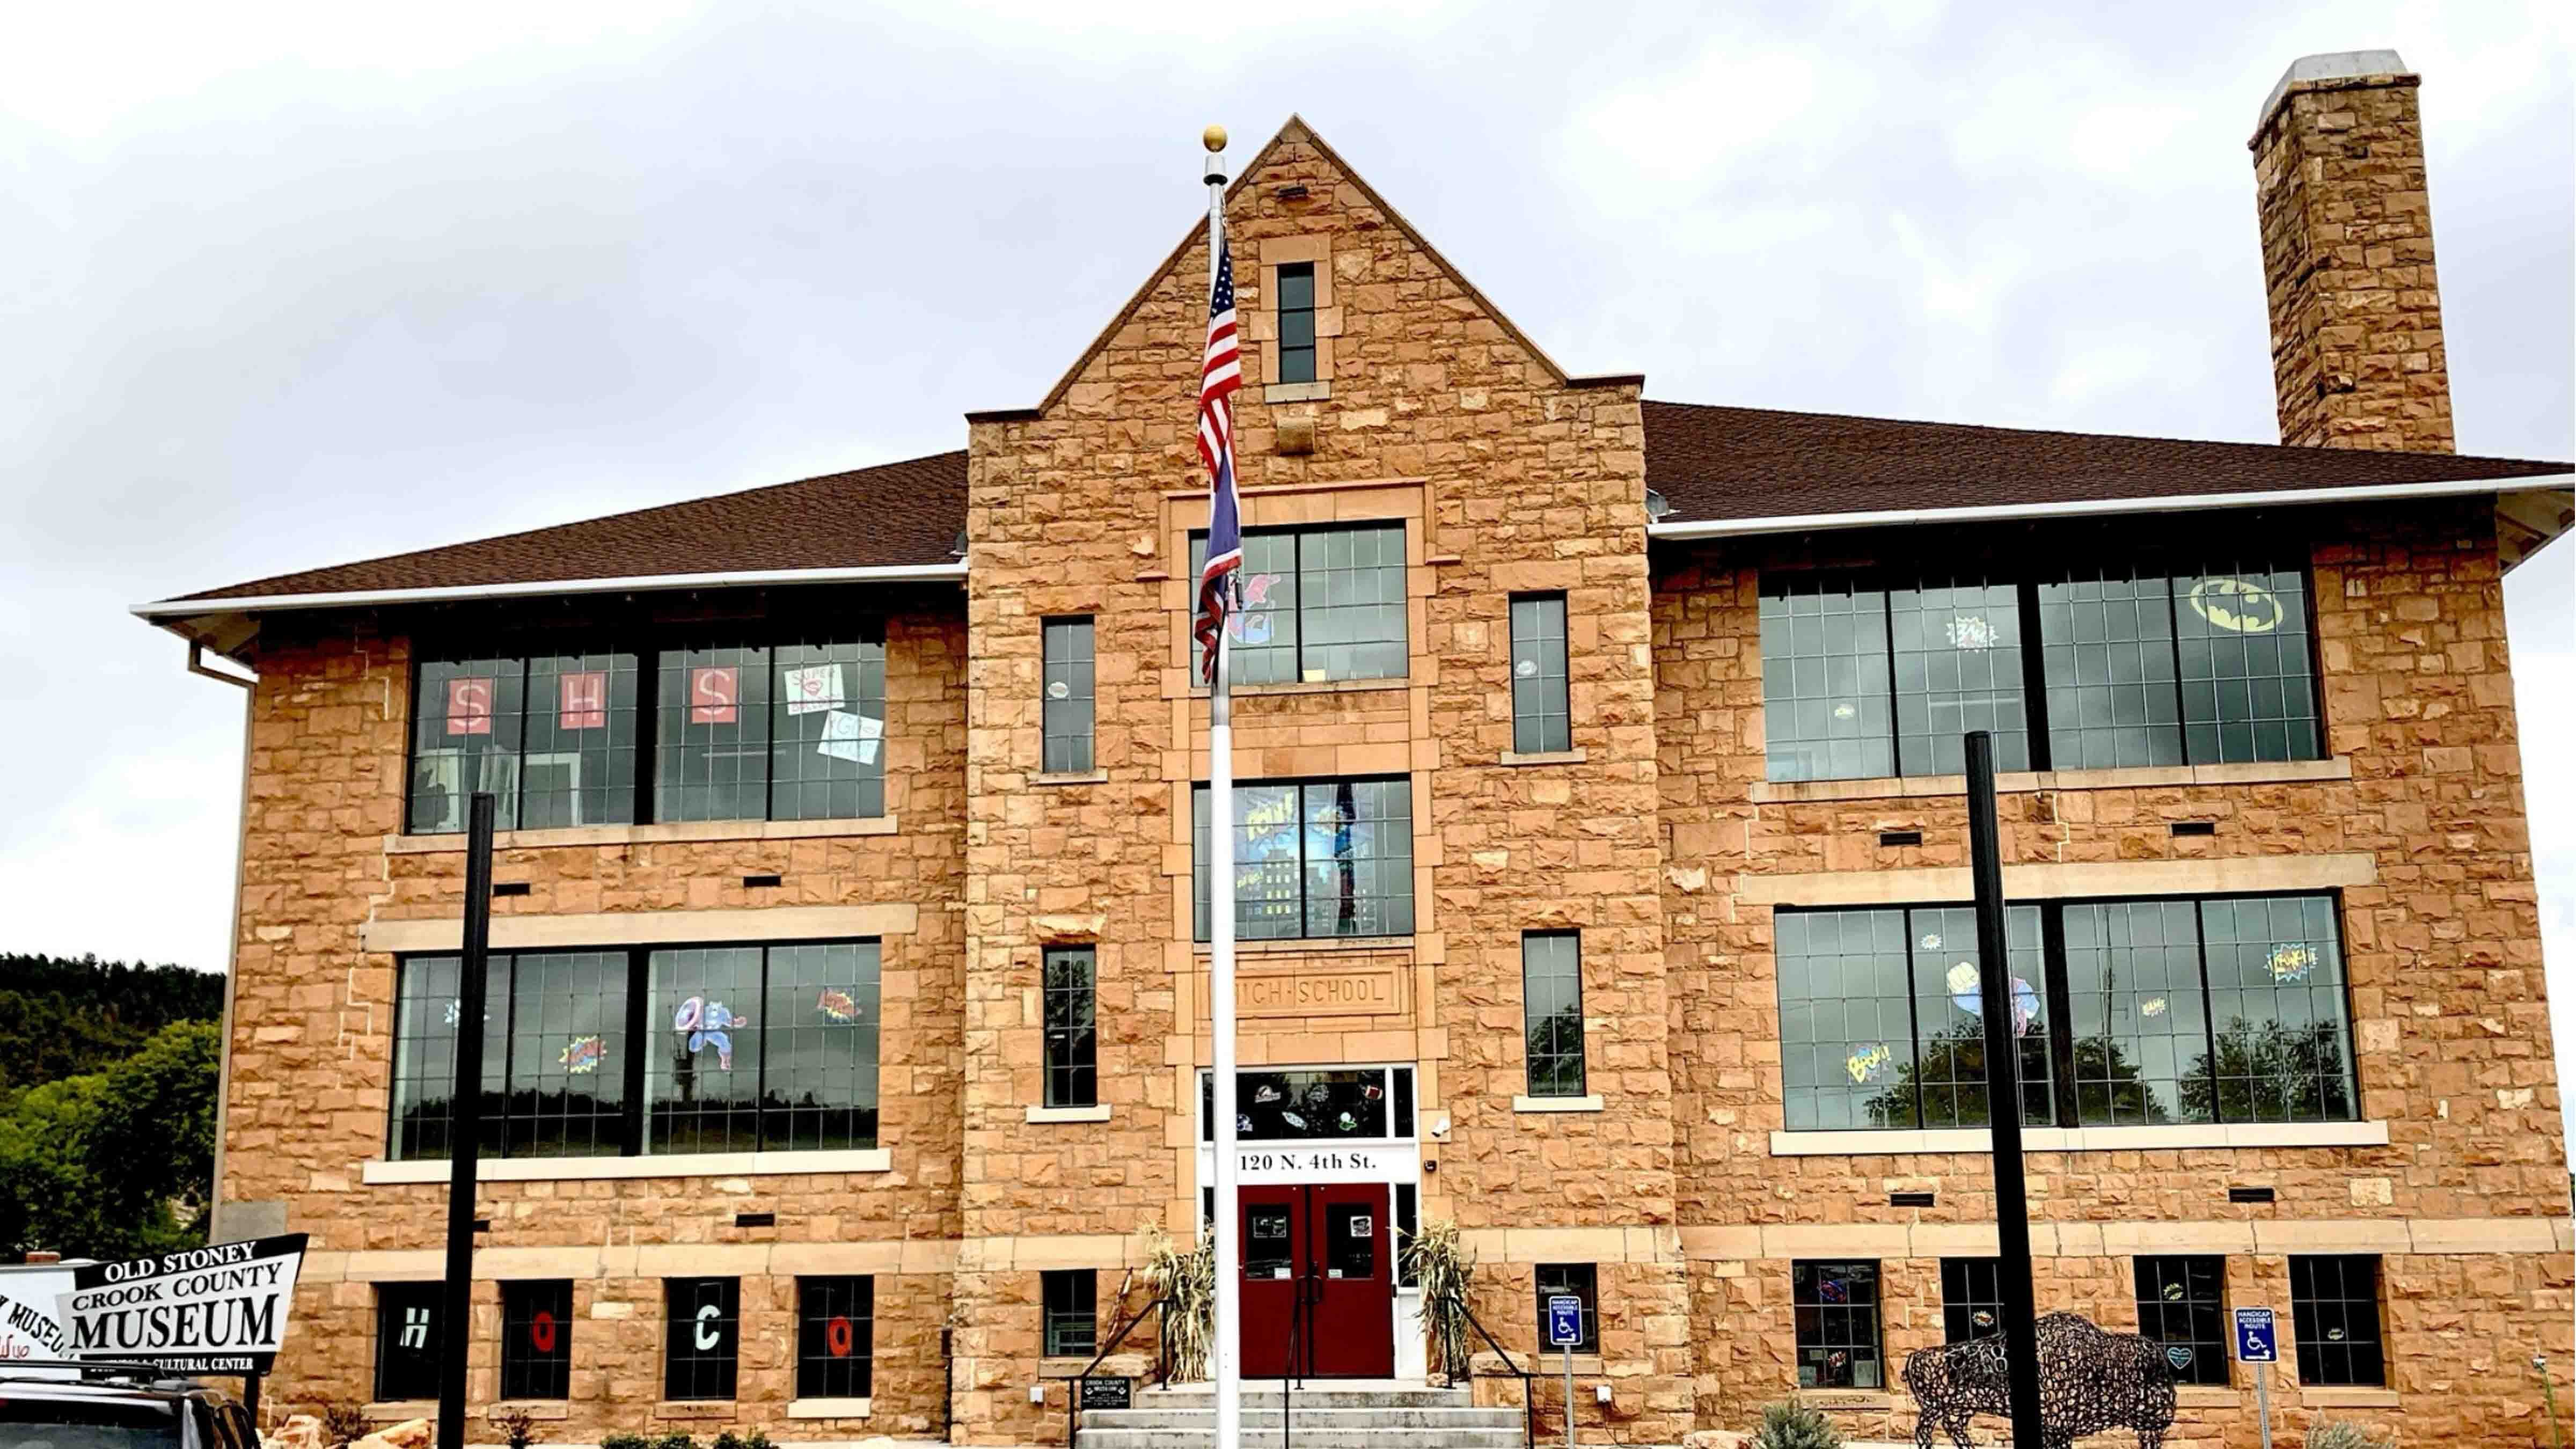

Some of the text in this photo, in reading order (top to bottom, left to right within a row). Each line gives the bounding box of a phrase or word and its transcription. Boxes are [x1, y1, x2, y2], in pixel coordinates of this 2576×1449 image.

[453, 669, 730, 730] S H S
[1235, 979, 1385, 1005] IGH SCHOOL
[1241, 1153, 1376, 1170] 120 N. 4th St.
[72, 1261, 283, 1311] CROOK COUNTY
[105, 1241, 258, 1283] OLD STONEY
[8, 1301, 75, 1359] MUSEU
[70, 1293, 279, 1349] MUSEUM
[399, 1304, 852, 1357] H O C O
[211, 1358, 253, 1370] CENTER
